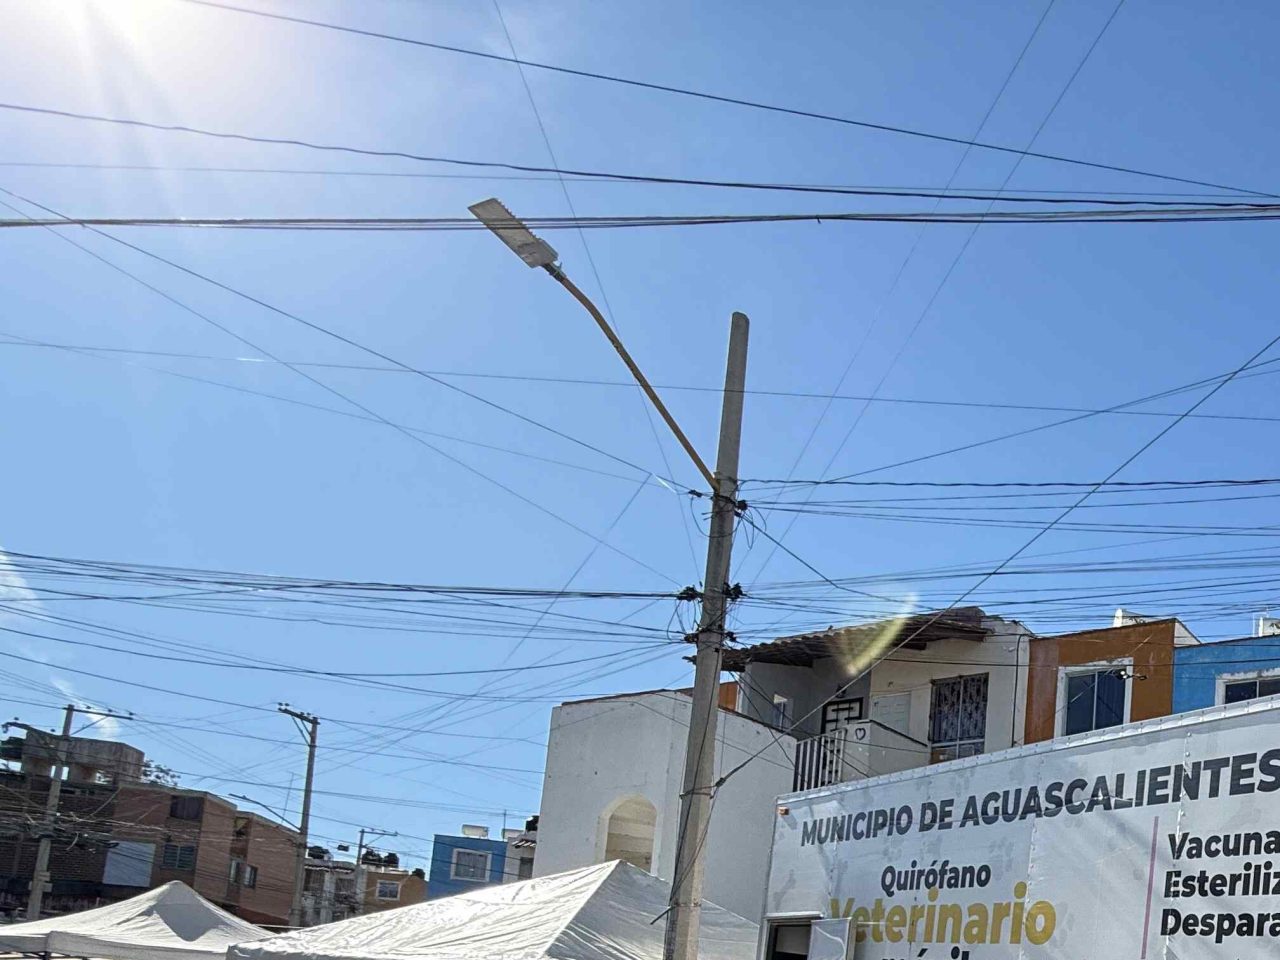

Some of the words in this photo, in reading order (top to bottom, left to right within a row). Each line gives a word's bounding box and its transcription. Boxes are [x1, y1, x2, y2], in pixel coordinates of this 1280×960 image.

[801, 805, 914, 847] MUNICIPIO
[919, 798, 955, 833] DE
[880, 859, 992, 898] Quirófano
